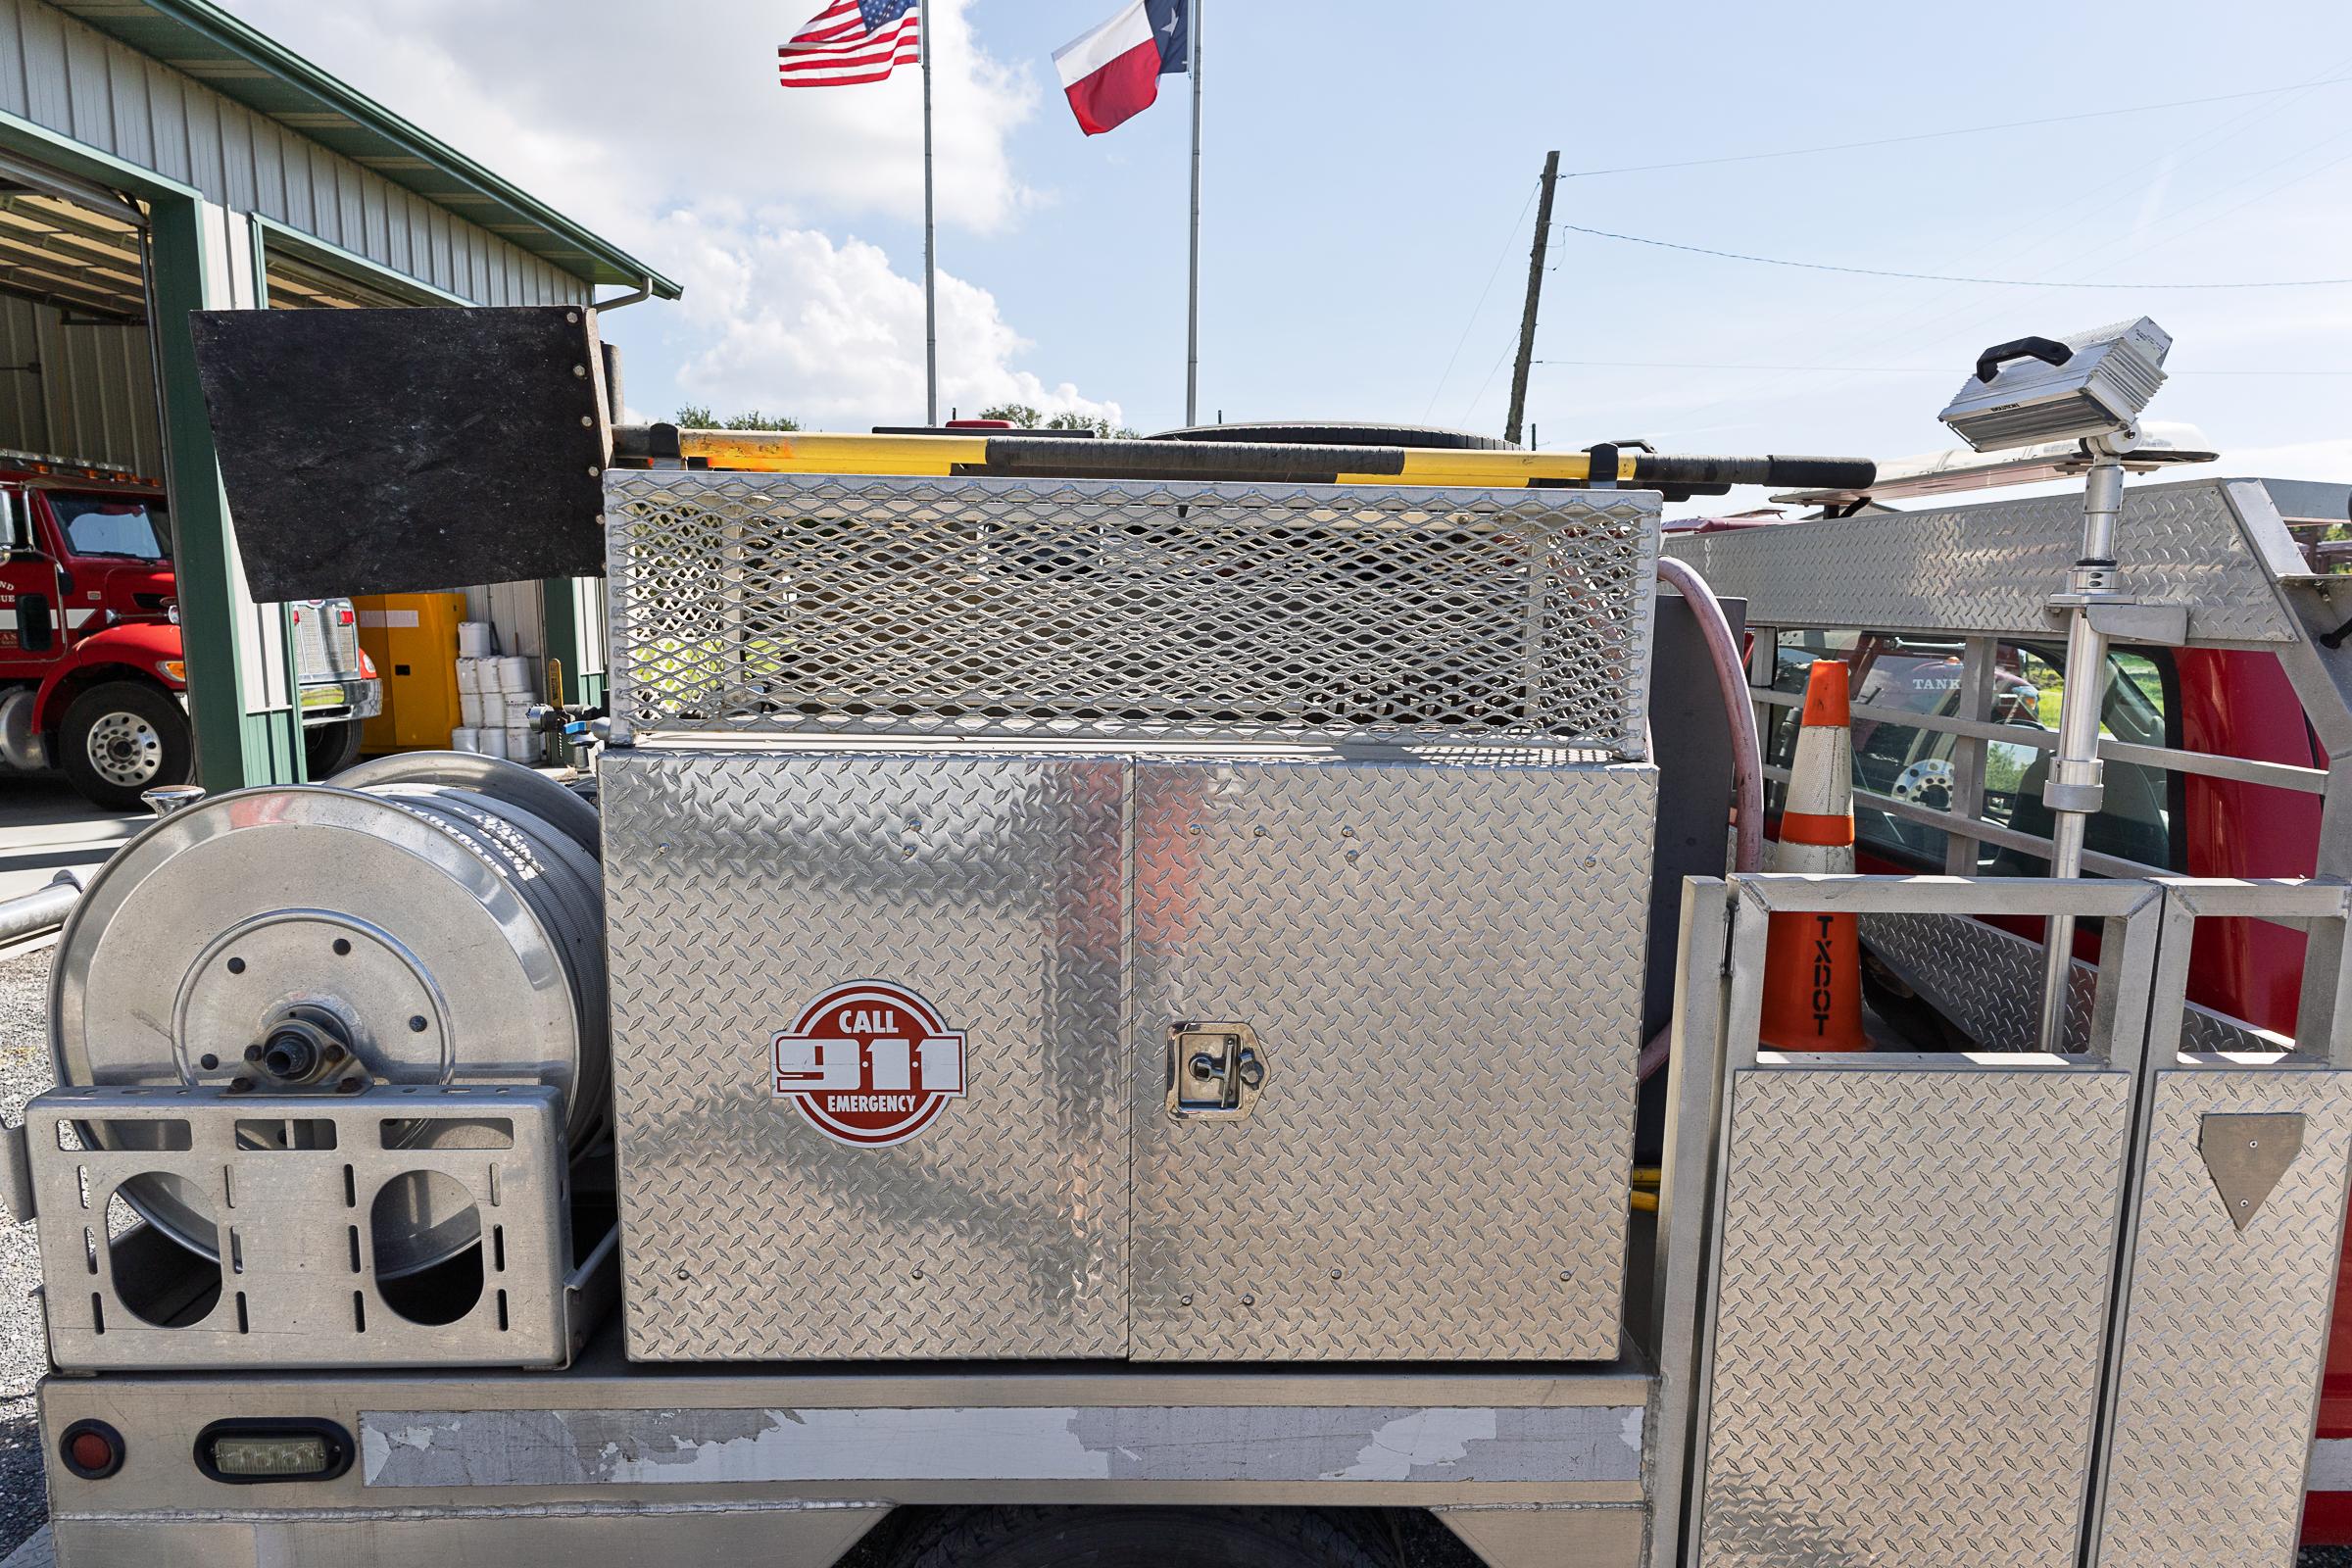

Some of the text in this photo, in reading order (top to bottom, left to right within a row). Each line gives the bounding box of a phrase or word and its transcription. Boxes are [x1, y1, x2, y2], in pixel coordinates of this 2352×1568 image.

[1913, 678, 1962, 690] TANK
[1812, 915, 1834, 1036] TXDOT
[839, 1010, 900, 1034] CALL
[827, 1096, 917, 1112] EMERGENCY
